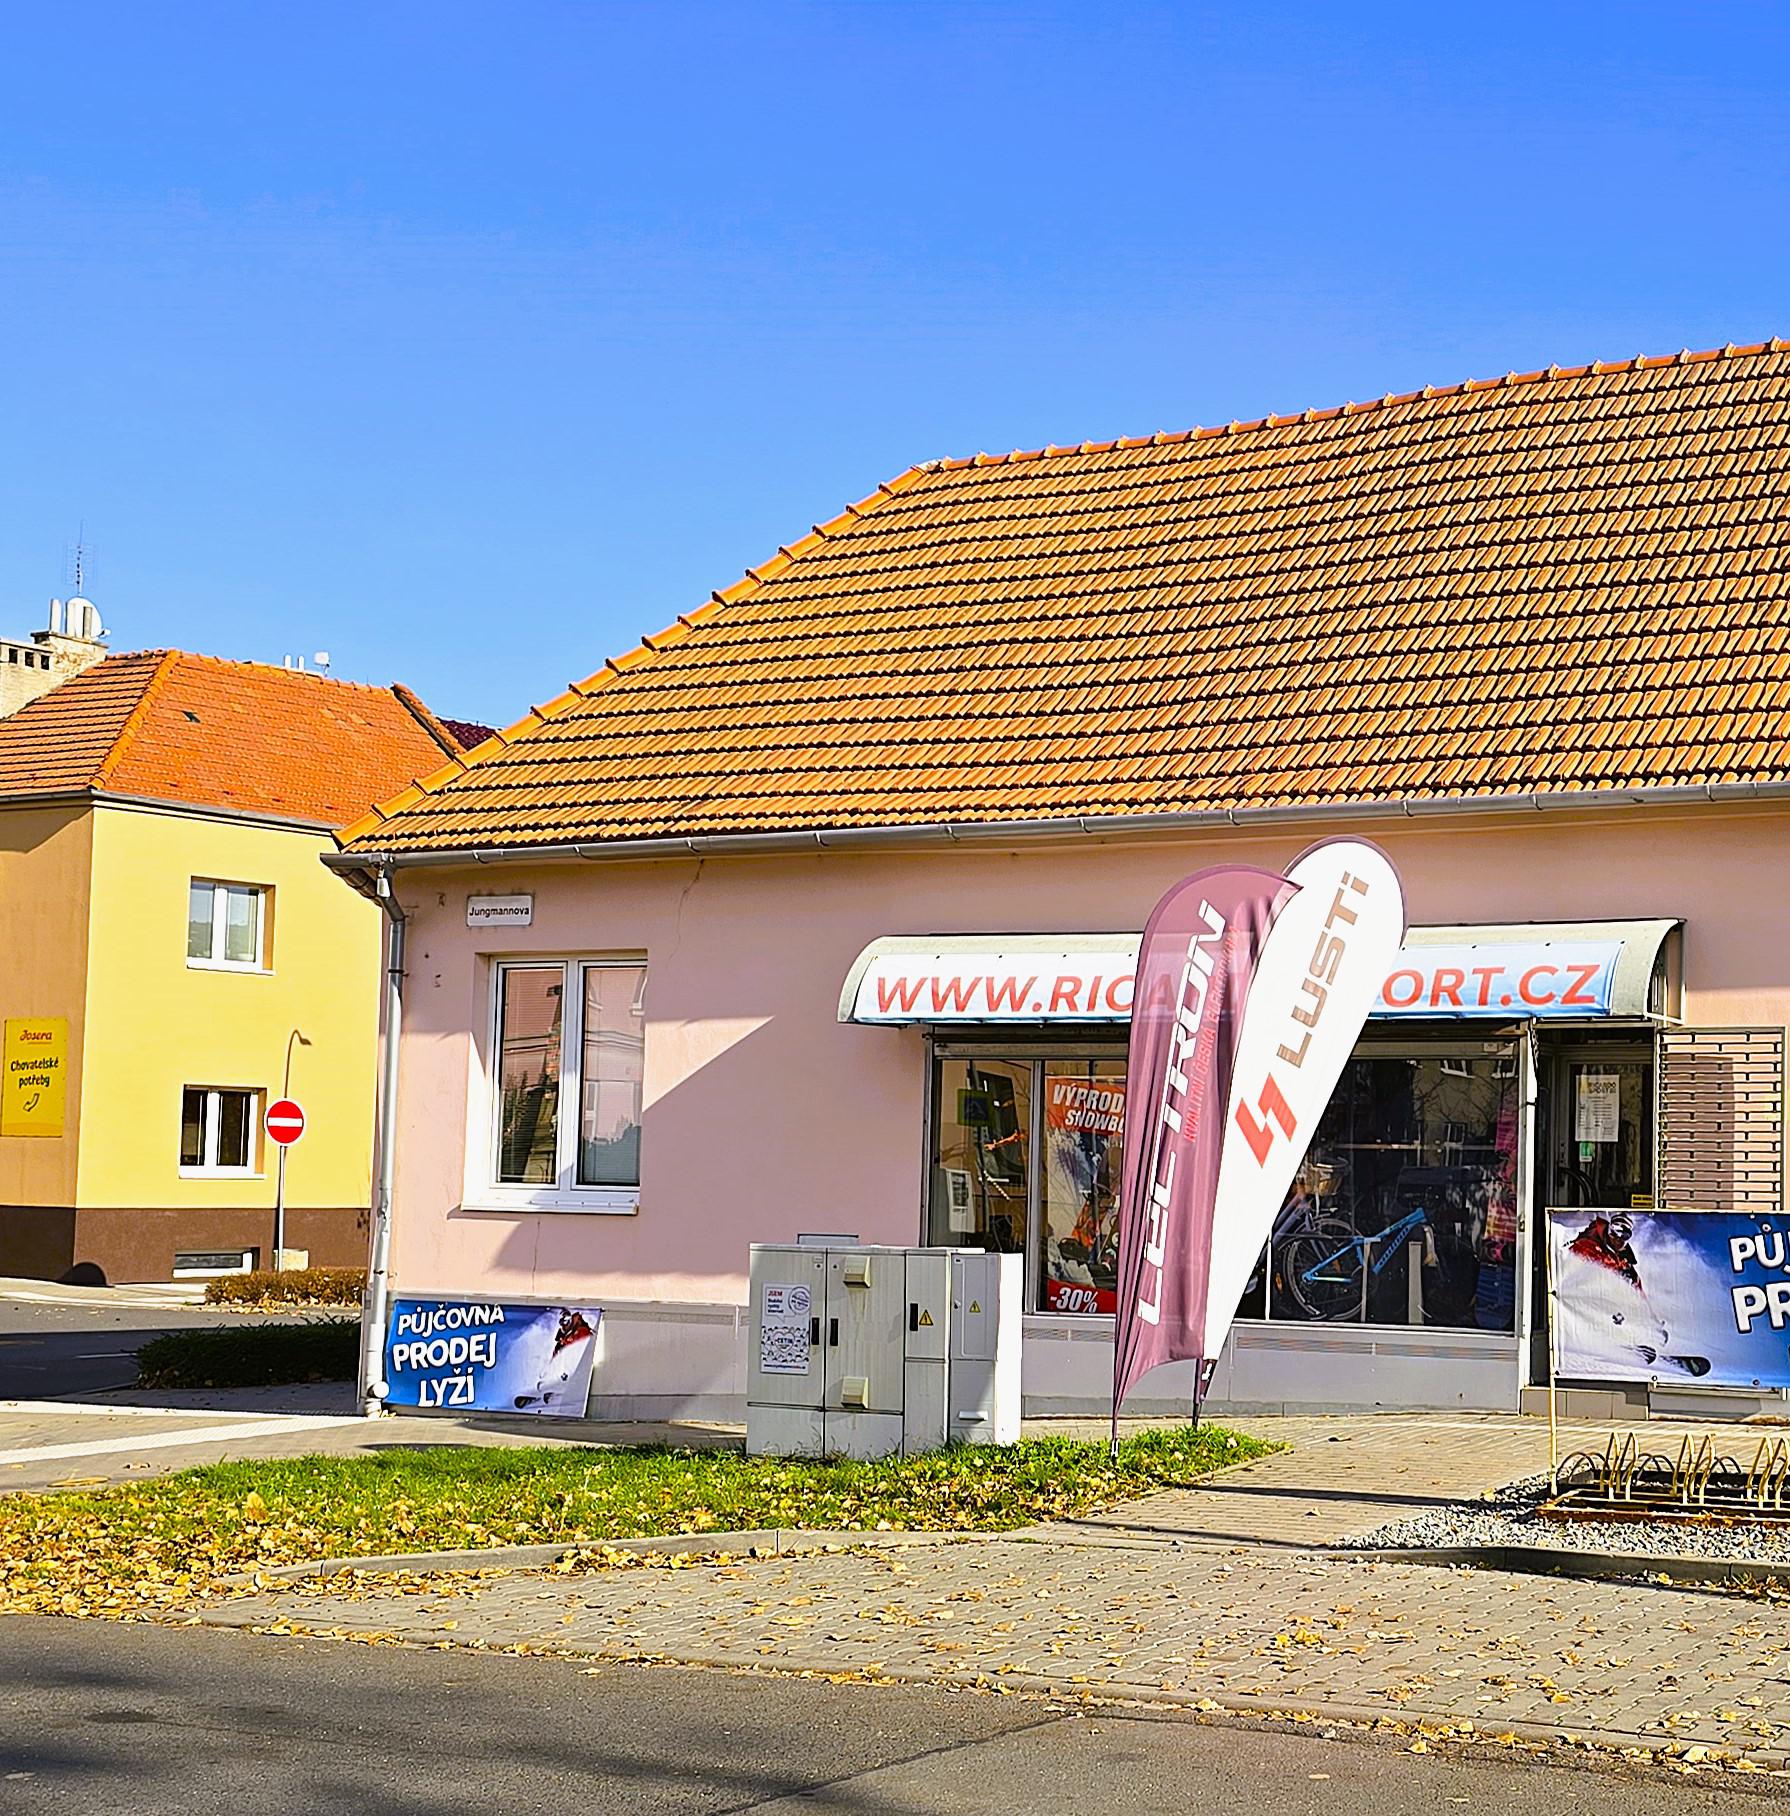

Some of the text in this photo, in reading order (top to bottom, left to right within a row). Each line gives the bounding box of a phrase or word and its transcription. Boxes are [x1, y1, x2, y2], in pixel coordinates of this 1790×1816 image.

[469, 907, 530, 918] Jungmannova
[11, 1056, 59, 1072] Chovatelské
[19, 1074, 50, 1089] potřeby
[1053, 1084, 1126, 1114] VÝPROD
[1050, 1287, 1098, 1312] -30%
[397, 1304, 505, 1338] PŮJČOVNA
[392, 1332, 497, 1371] PRODEJ
[418, 1368, 475, 1408] LYŽÍ
